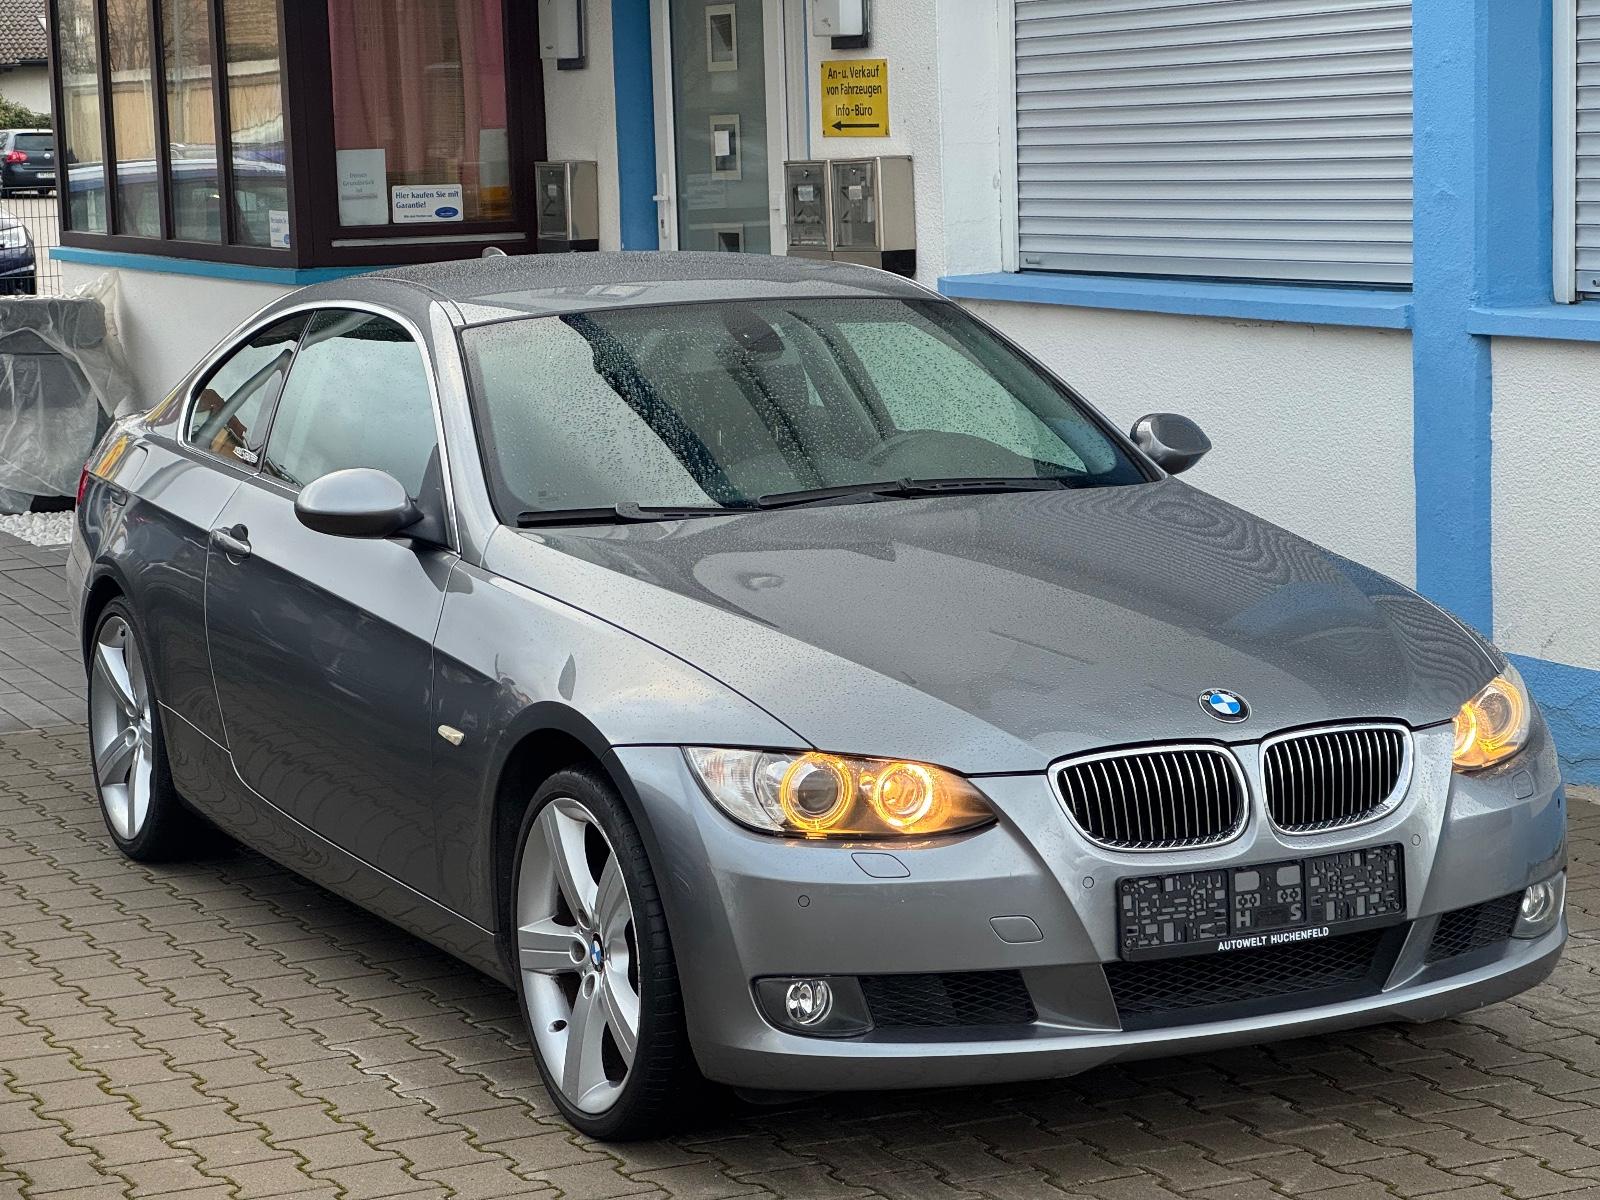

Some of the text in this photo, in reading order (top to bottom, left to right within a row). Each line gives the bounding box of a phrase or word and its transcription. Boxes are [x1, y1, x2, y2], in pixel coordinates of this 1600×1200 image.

[849, 65, 880, 79] Verkauf
[826, 82, 882, 97] von Fahrzeugen
[395, 191, 409, 199] Hier
[411, 191, 434, 199] kaufen
[435, 190, 446, 198] Sie
[396, 201, 426, 209] Garantie!
[1217, 927, 1329, 951] AUTOWELT HUCHENFELD
